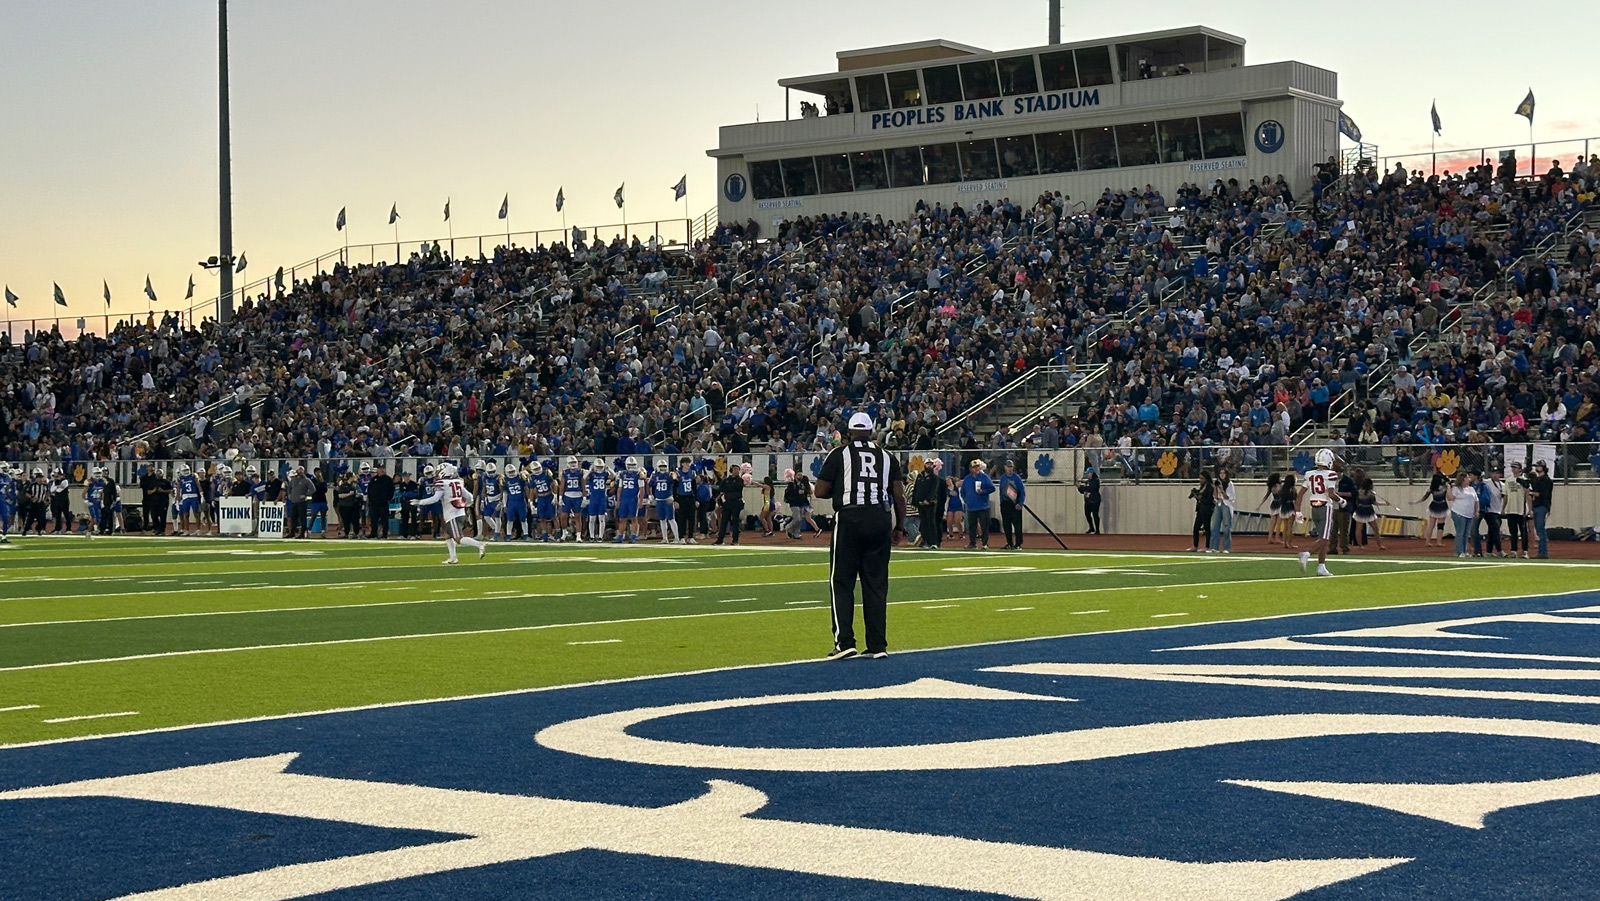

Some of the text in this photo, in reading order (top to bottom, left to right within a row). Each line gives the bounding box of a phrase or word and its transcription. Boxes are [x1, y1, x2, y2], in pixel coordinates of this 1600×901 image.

[871, 88, 1100, 130] PEOPLES BANK STADIUM
[1189, 159, 1246, 172] RESERVED SEATING
[957, 181, 1006, 193] RESERVED SEATING
[758, 199, 802, 209] RESERVED SEATING
[859, 451, 878, 478] R
[185, 483, 192, 493] 3
[449, 481, 462, 498] 15
[593, 479, 605, 490] 38
[1309, 474, 1326, 495] 13
[220, 507, 251, 520] THINK
[260, 507, 283, 519] TURN
[259, 520, 282, 533] OVER
